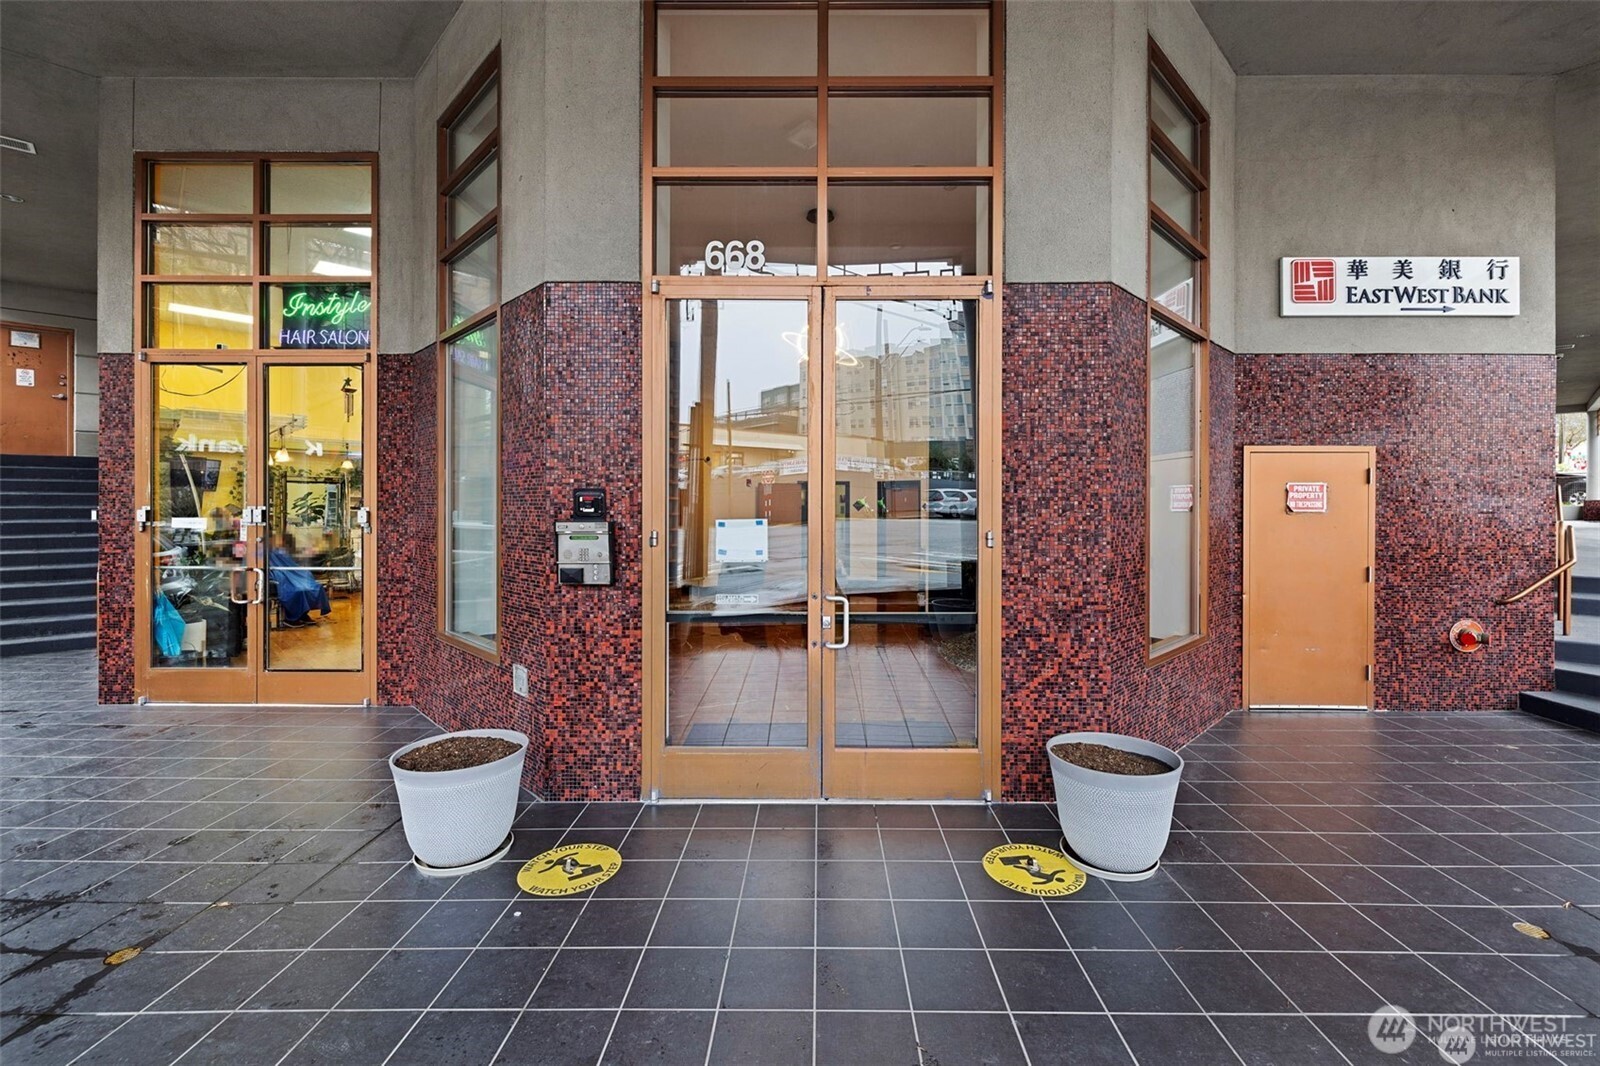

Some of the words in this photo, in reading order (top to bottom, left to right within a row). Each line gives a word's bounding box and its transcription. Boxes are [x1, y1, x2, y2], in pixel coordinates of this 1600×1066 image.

[705, 240, 766, 270] 668
[1346, 258, 1510, 281] 華美銀行
[1452, 286, 1511, 304] BANK
[282, 290, 372, 325] Instyle
[279, 329, 317, 345] HAIR
[319, 329, 370, 345] SALON
[1289, 492, 1324, 500] PROPERTY
[1293, 485, 1319, 493] PRIVATE
[998, 844, 1023, 854] YOUR
[521, 851, 552, 873] WATCH
[553, 844, 584, 854] YOUR
[584, 844, 610, 852] STEP
[986, 850, 1000, 865] STEP
[528, 885, 568, 895] WATCH
[571, 877, 604, 892] YOUR
[601, 862, 619, 880] STEP
[1000, 879, 1027, 892] STEP
[1030, 888, 1064, 896] YOUR
